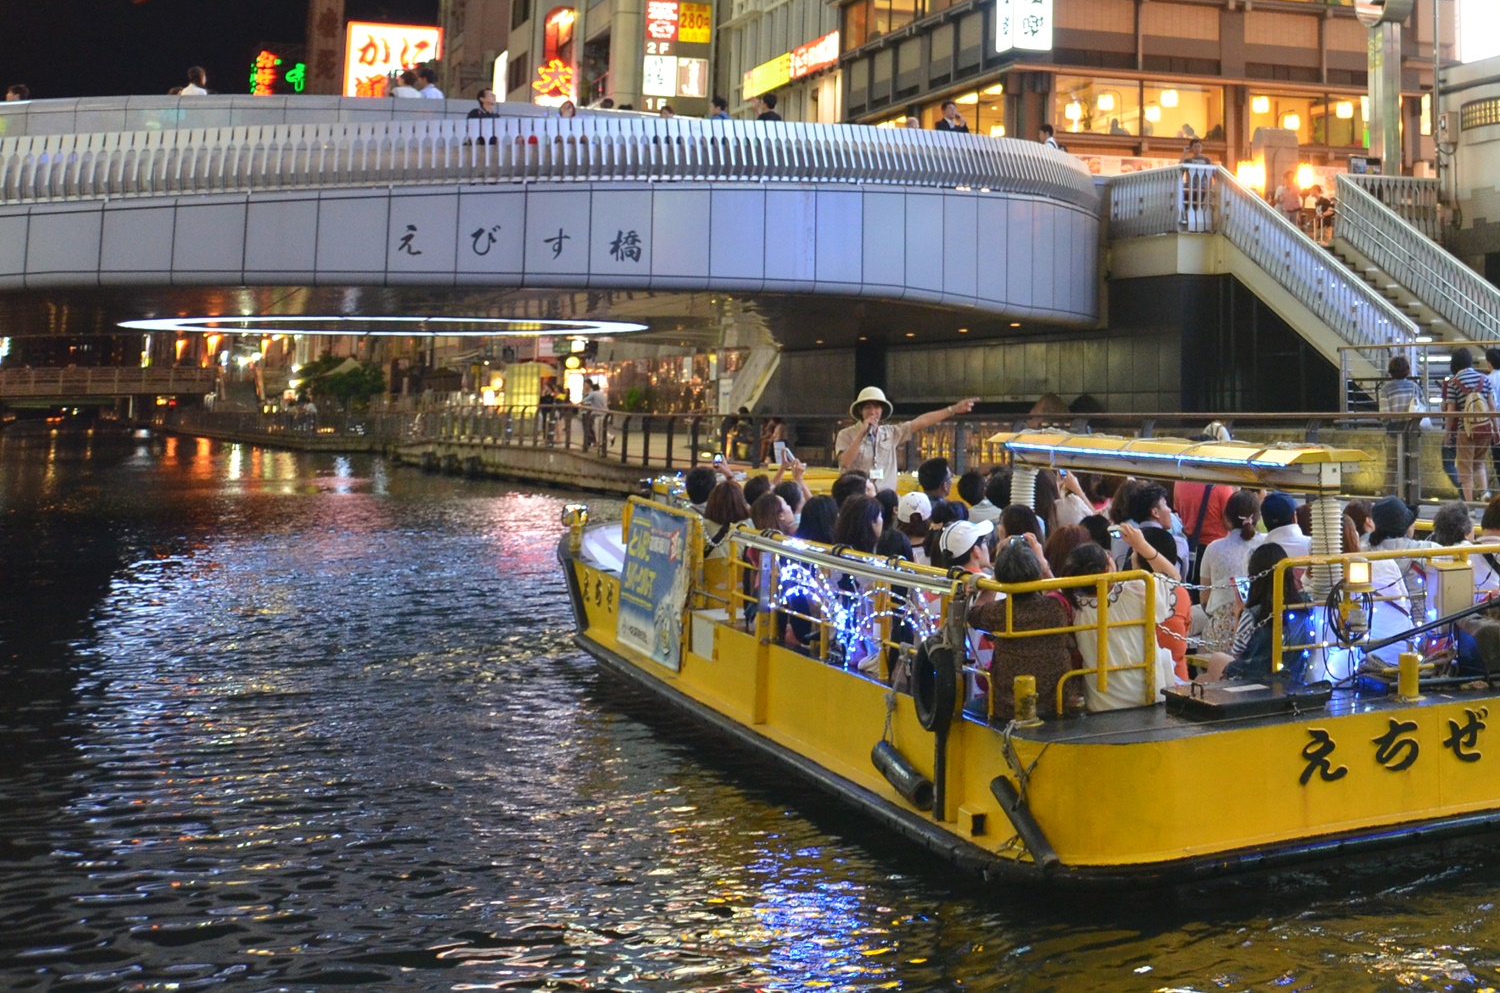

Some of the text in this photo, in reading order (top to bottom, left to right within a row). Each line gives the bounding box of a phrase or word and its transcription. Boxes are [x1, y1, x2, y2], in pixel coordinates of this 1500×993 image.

[646, 41, 670, 55] 2F
[396, 224, 643, 264] えびす橋
